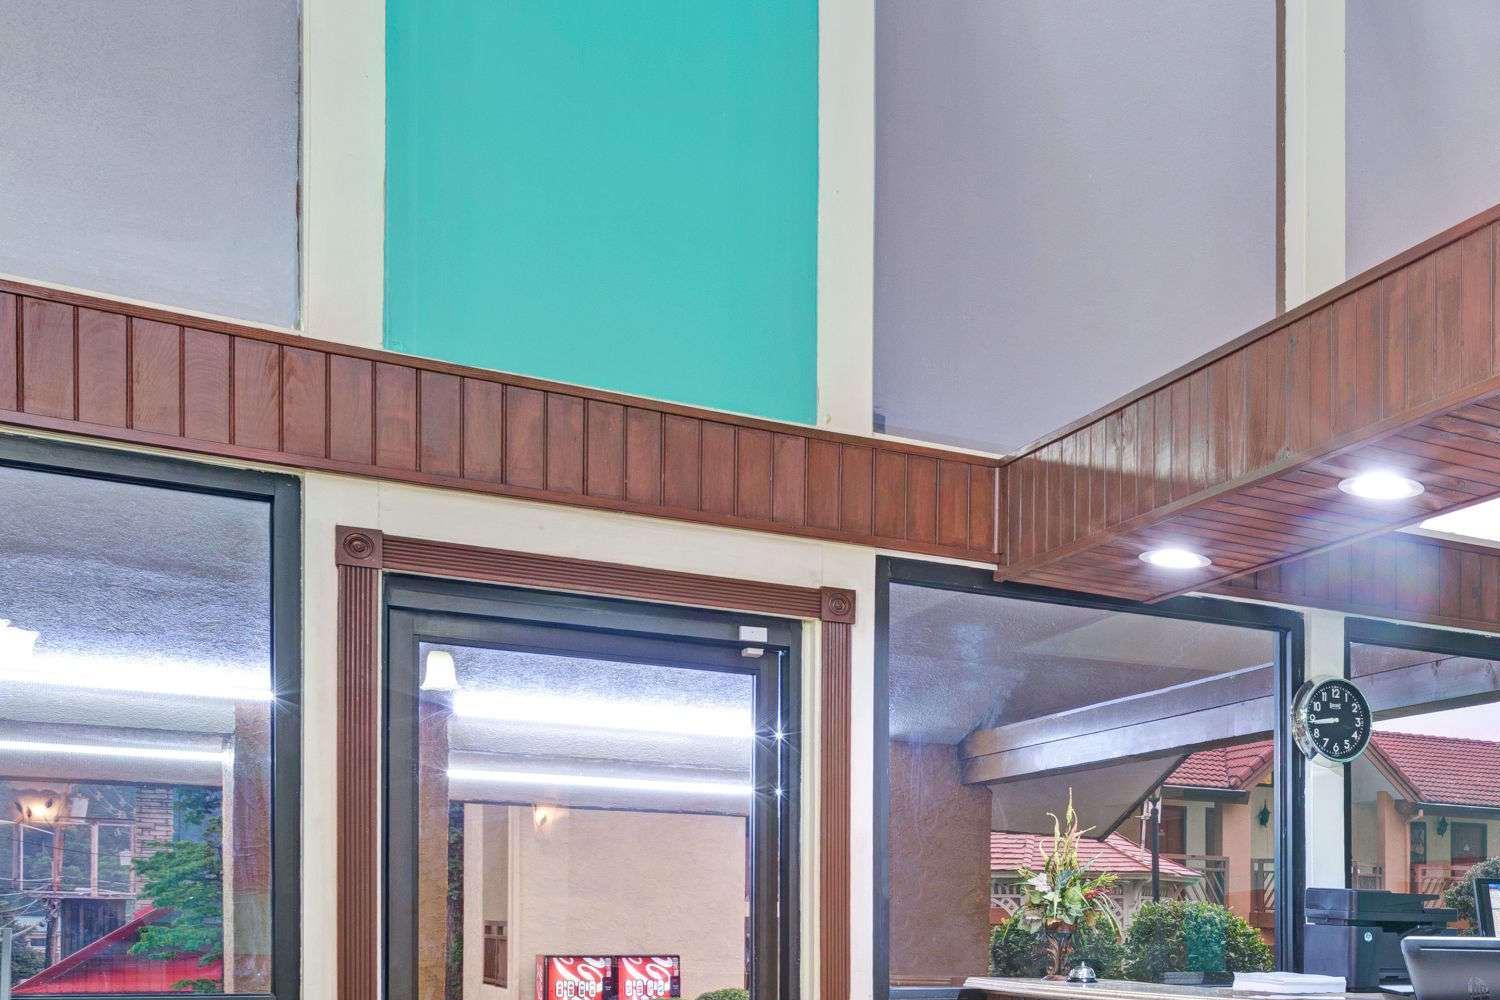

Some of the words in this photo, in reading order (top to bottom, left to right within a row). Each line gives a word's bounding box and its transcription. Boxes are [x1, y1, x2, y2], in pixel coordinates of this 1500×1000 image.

[1322, 692, 1327, 701] 11
[1332, 688, 1340, 698] 12
[1313, 702, 1320, 711] 10
[1352, 703, 1357, 713] 2
[1355, 718, 1360, 727] 3
[1314, 728, 1320, 738] 8
[1352, 730, 1358, 739] 4
[1323, 738, 1329, 747] 7
[1344, 740, 1350, 749] 5
[1333, 743, 1339, 752] 6
